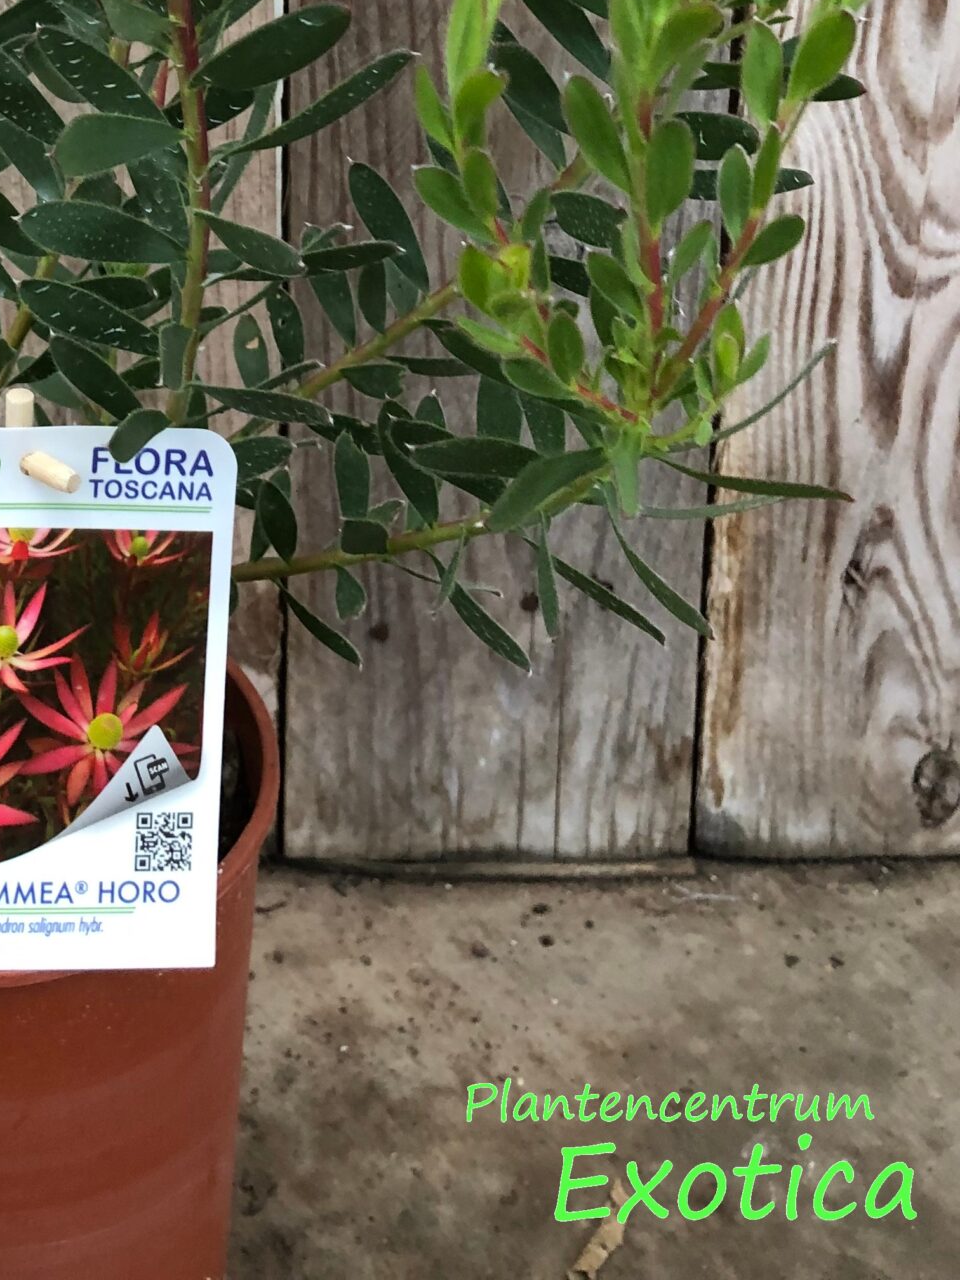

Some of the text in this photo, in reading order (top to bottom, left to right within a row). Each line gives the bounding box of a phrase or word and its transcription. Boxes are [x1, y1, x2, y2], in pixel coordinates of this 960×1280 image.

[89, 479, 212, 501] TOSCANA
[149, 762, 168, 774] SCAN
[98, 879, 181, 904] HORO
